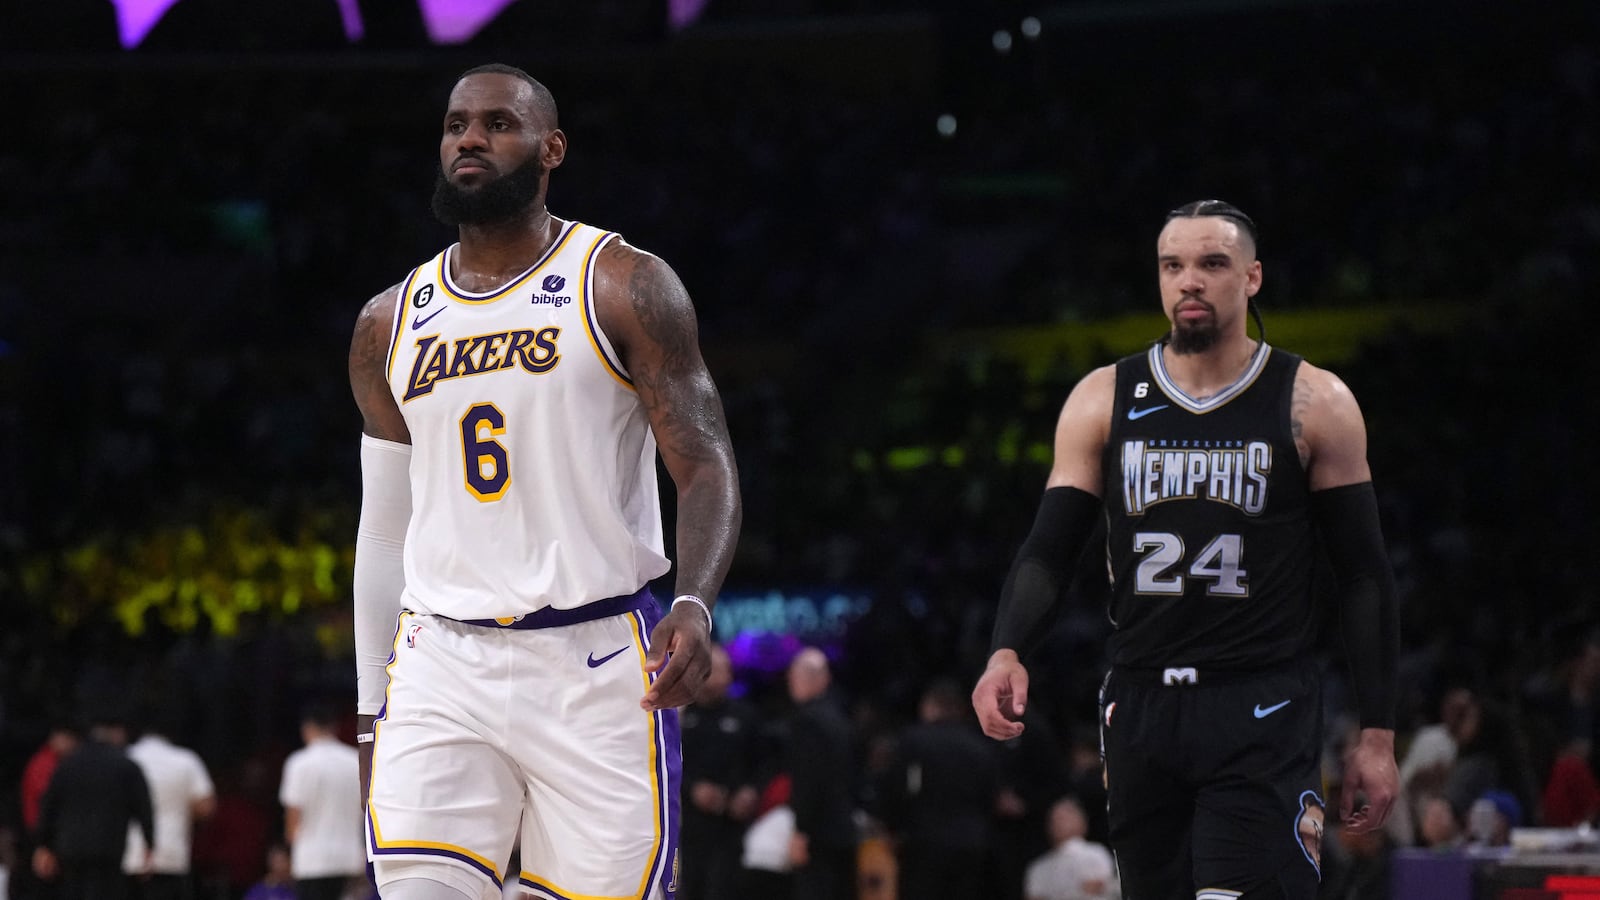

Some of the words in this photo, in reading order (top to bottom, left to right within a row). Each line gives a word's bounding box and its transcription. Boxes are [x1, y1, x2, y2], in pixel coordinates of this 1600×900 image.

[417, 289, 430, 306] 6
[531, 293, 571, 307] bibigo
[403, 328, 562, 405] LAKERS
[1134, 382, 1149, 398] 6
[459, 401, 512, 503] 6
[1149, 439, 1243, 448] GRIZZLIES
[1122, 439, 1272, 516] MEMPHIS
[1133, 531, 1250, 597] 24
